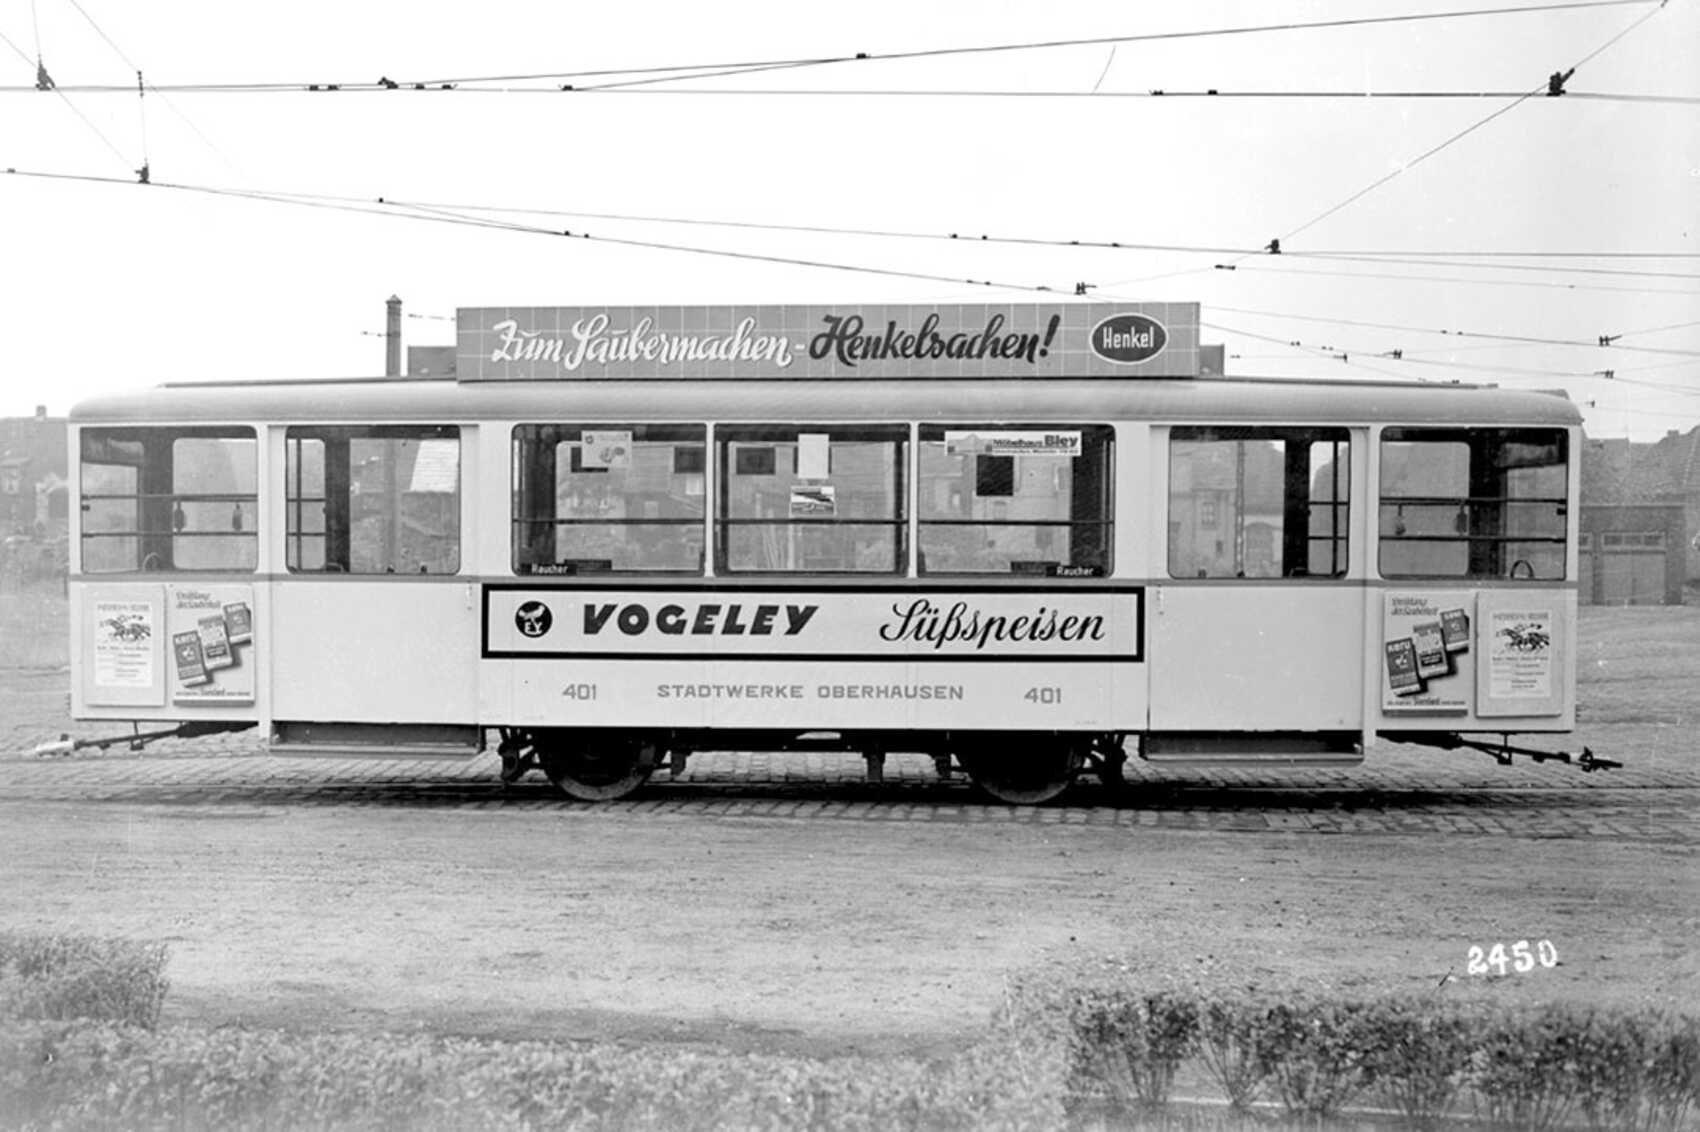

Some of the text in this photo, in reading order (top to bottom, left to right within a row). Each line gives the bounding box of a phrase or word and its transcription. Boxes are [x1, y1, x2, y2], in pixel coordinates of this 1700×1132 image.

[492, 320, 563, 362] Zum
[564, 314, 793, 370] Saubermachen
[808, 313, 1061, 367] Henkelsachen!
[1103, 326, 1154, 348] Henkel
[1044, 434, 1078, 447] Bley
[1056, 565, 1094, 577] Raucher
[584, 599, 1105, 650] VOGELEY Süßspeisen
[562, 683, 1062, 705] 401 STADTWERKE OBERHAUSEN 401
